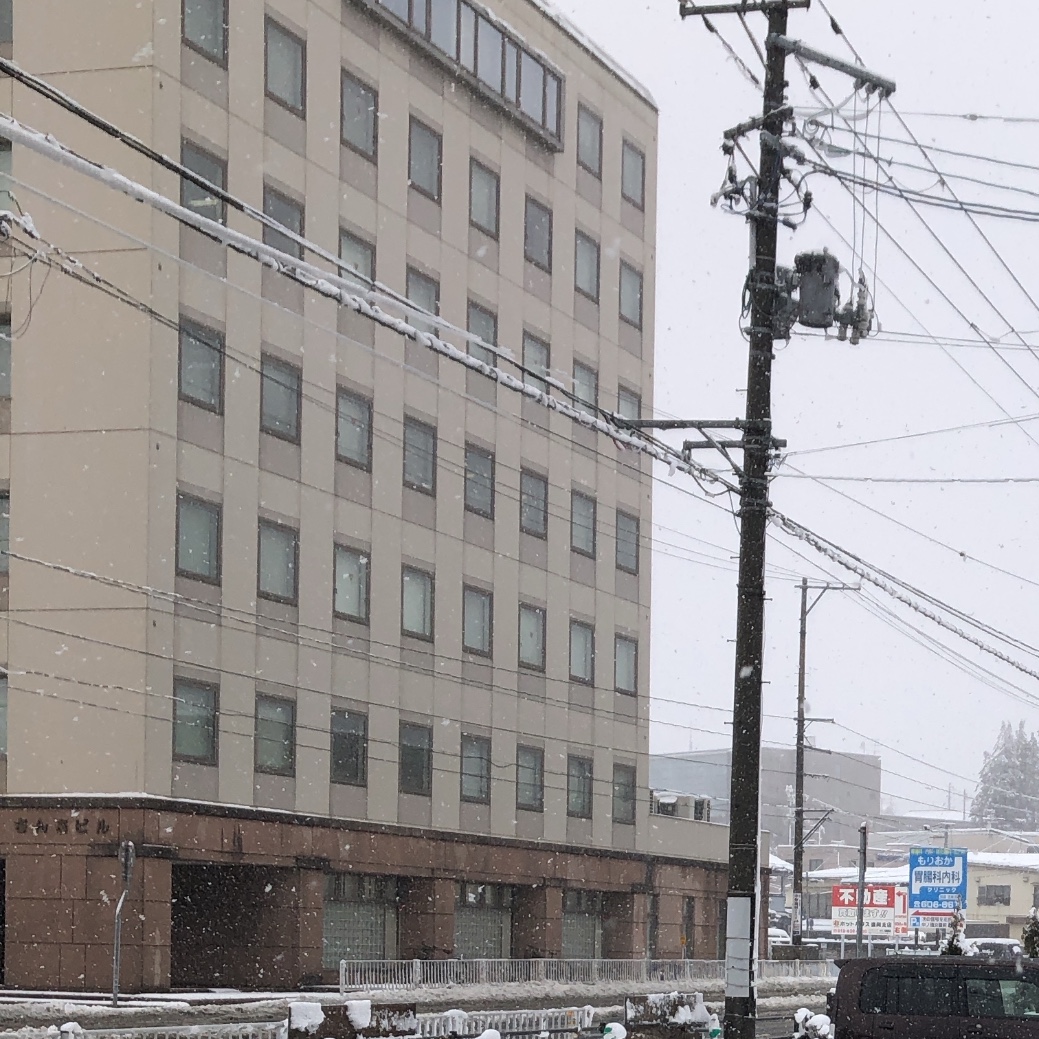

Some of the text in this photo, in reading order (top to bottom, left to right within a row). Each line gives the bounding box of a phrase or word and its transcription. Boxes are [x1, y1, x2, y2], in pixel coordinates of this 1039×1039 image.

[918, 856, 953, 866] もりおか
[914, 870, 960, 884] 胃腸科内科
[839, 888, 888, 905] 不動産
